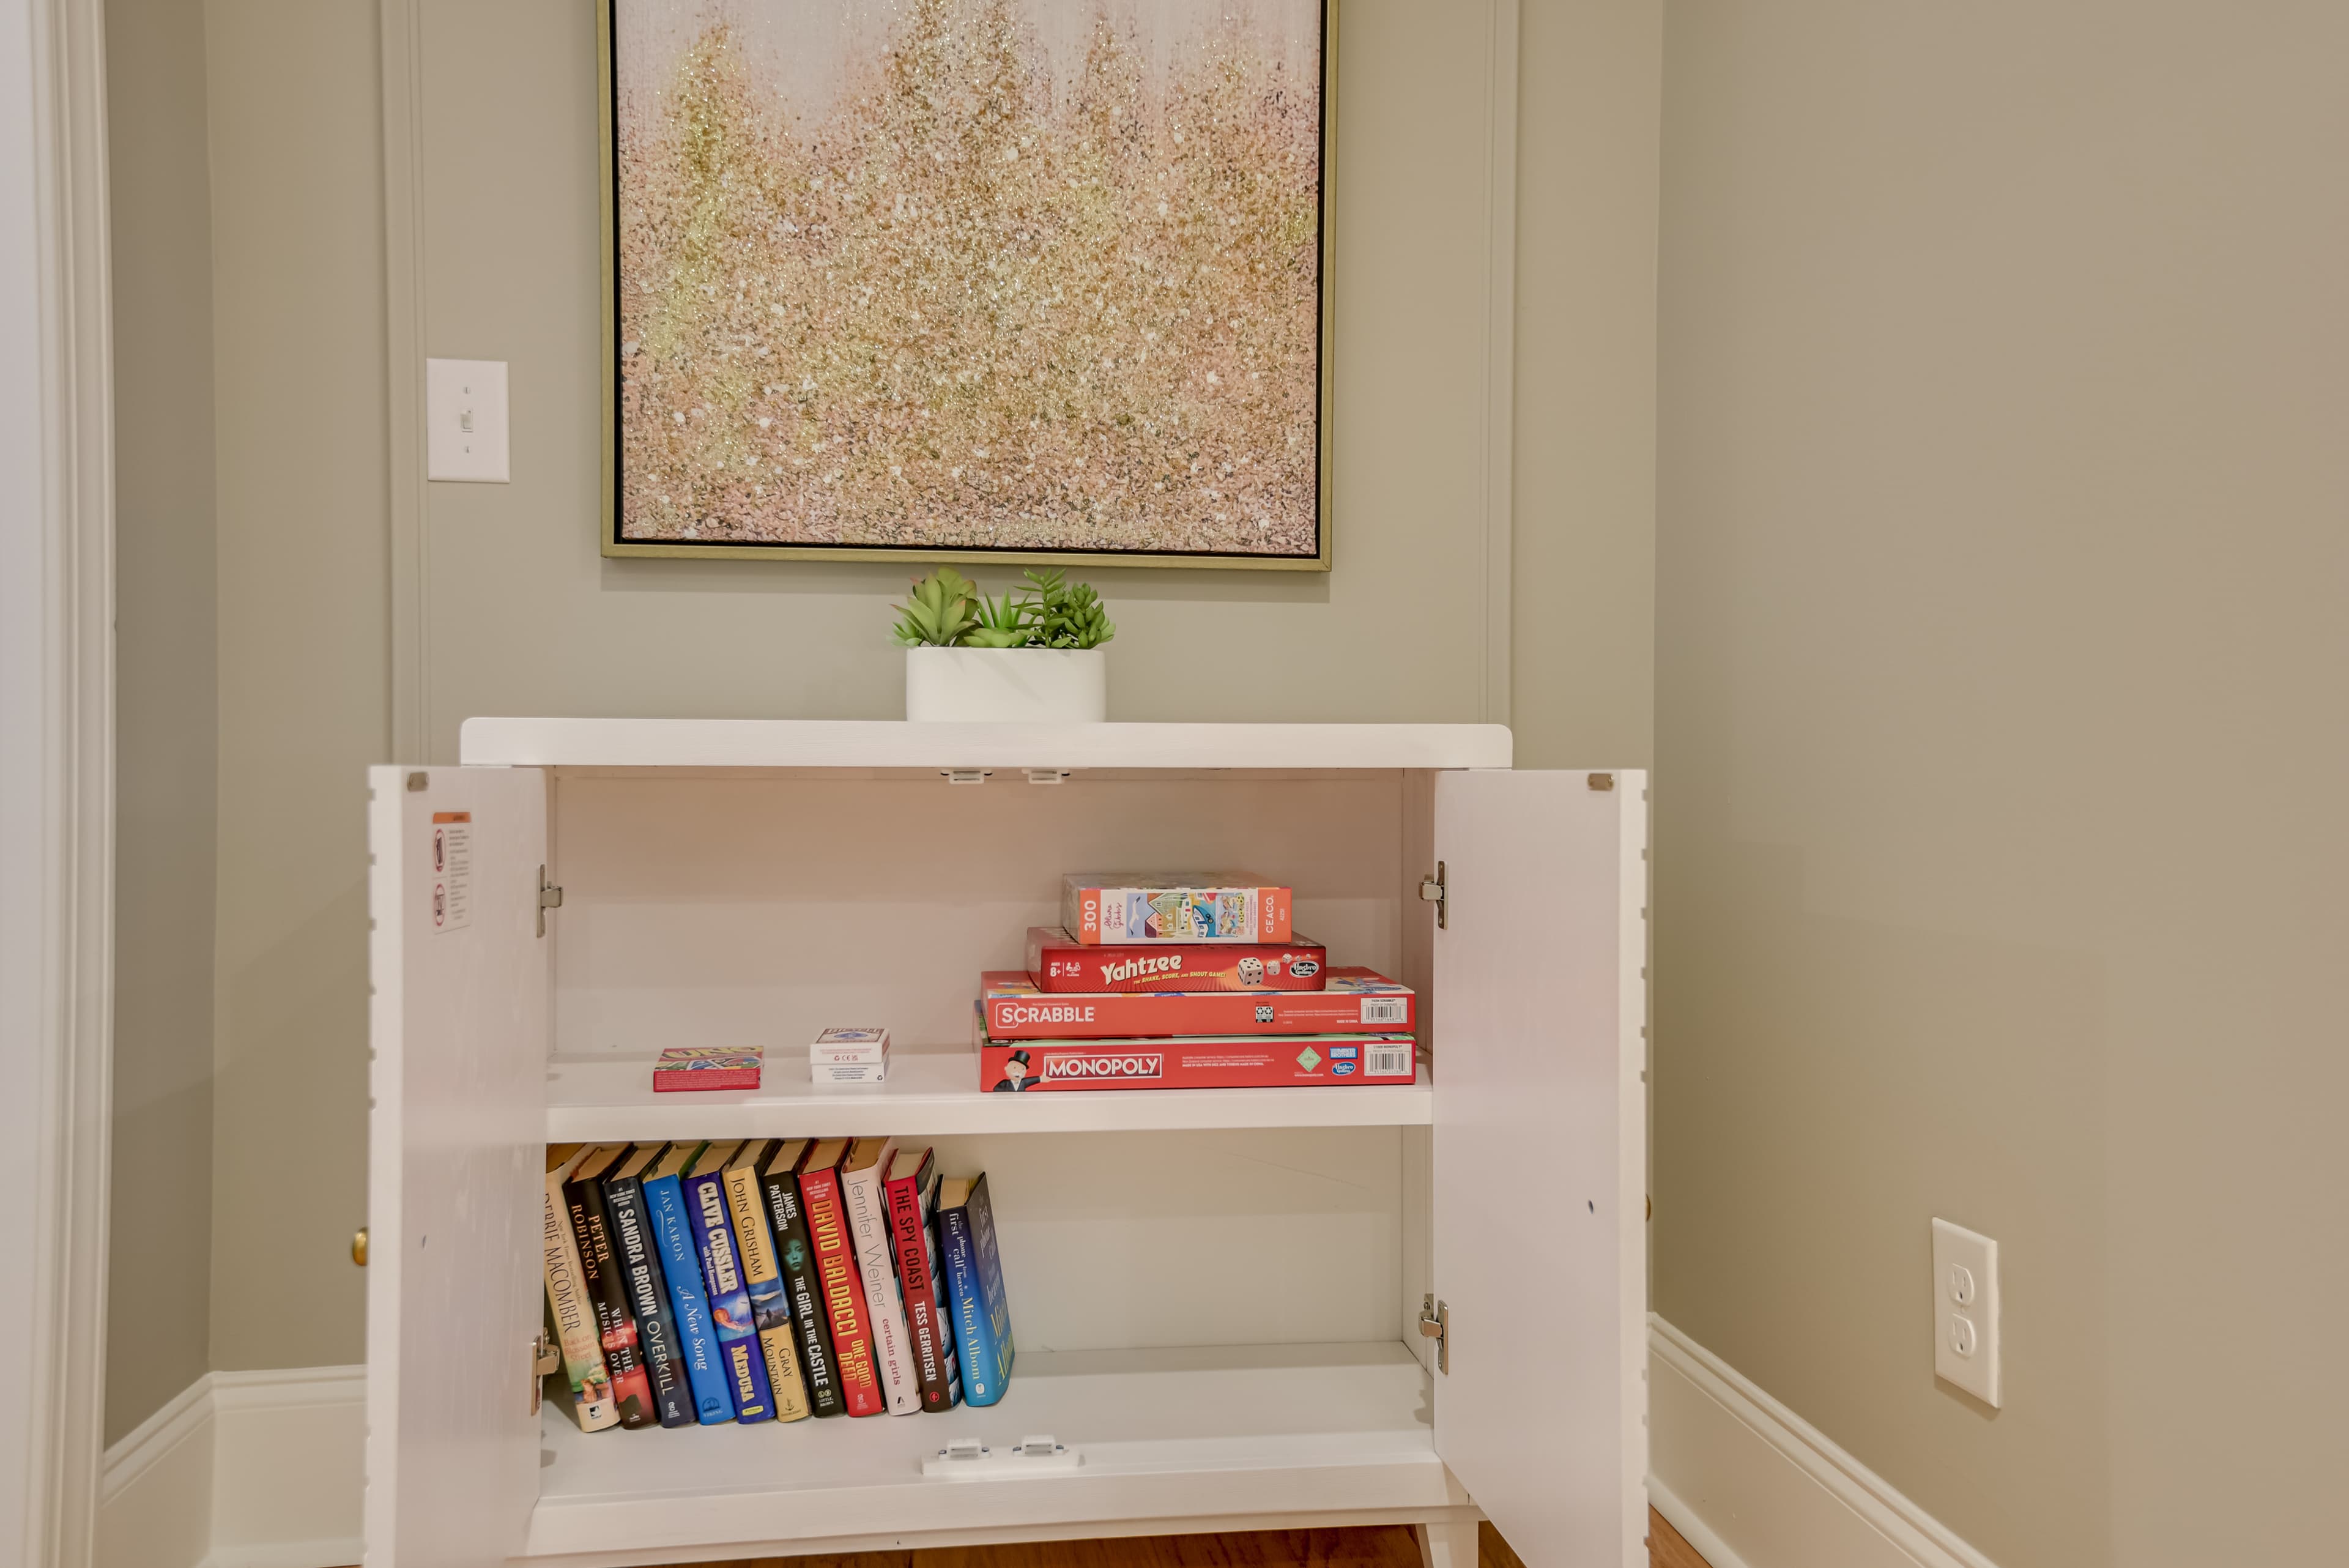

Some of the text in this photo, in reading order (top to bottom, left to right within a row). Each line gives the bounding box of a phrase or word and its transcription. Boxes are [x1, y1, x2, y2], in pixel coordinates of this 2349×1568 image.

[1083, 900, 1097, 932] 300
[1050, 967, 1061, 977] 8+
[1100, 955, 1182, 985] Yahtzee
[1001, 1007, 1095, 1024] SCRABBLE
[1048, 1058, 1159, 1077] MONOPOLY
[660, 1190, 685, 1261] JAN KARON
[730, 1177, 764, 1277] JOHN GRISHAM
[769, 1184, 789, 1232] PATTERSON
[782, 1192, 798, 1219] JAMES
[949, 1213, 959, 1235] first
[571, 1204, 599, 1279] ROBINSON
[588, 1214, 609, 1263] PETER
[697, 1181, 738, 1295] CLIVE CUSSLER
[847, 1179, 886, 1307] Jennifer Weiner
[894, 1186, 924, 1290] THE SPY COAST
[953, 1249, 965, 1268] call
[957, 1236, 967, 1258] phone
[544, 1247, 581, 1333] MACOMBER
[811, 1199, 858, 1337] DAVID BALDACCI
[618, 1208, 645, 1265] SANDRA
[632, 1265, 658, 1317] BROWN
[647, 1321, 675, 1396] OVERKILL
[677, 1285, 708, 1371] A New Song
[795, 1276, 829, 1387] THE GIRL IN THE CASTLE
[597, 1301, 613, 1339] MUSIC
[610, 1352, 624, 1384] OVER
[611, 1307, 634, 1373] WHEN THE
[763, 1337, 783, 1395] MOUNTAIN
[779, 1348, 793, 1378] GRAY
[839, 1351, 857, 1381] DEED
[851, 1339, 866, 1361] ONE
[882, 1318, 901, 1386] certain girls
[914, 1301, 937, 1382] TESS GERRITSEN
[962, 1297, 981, 1380] Mitch Albom
[731, 1344, 755, 1403] MEDUSA
[856, 1360, 872, 1388] GOOD
